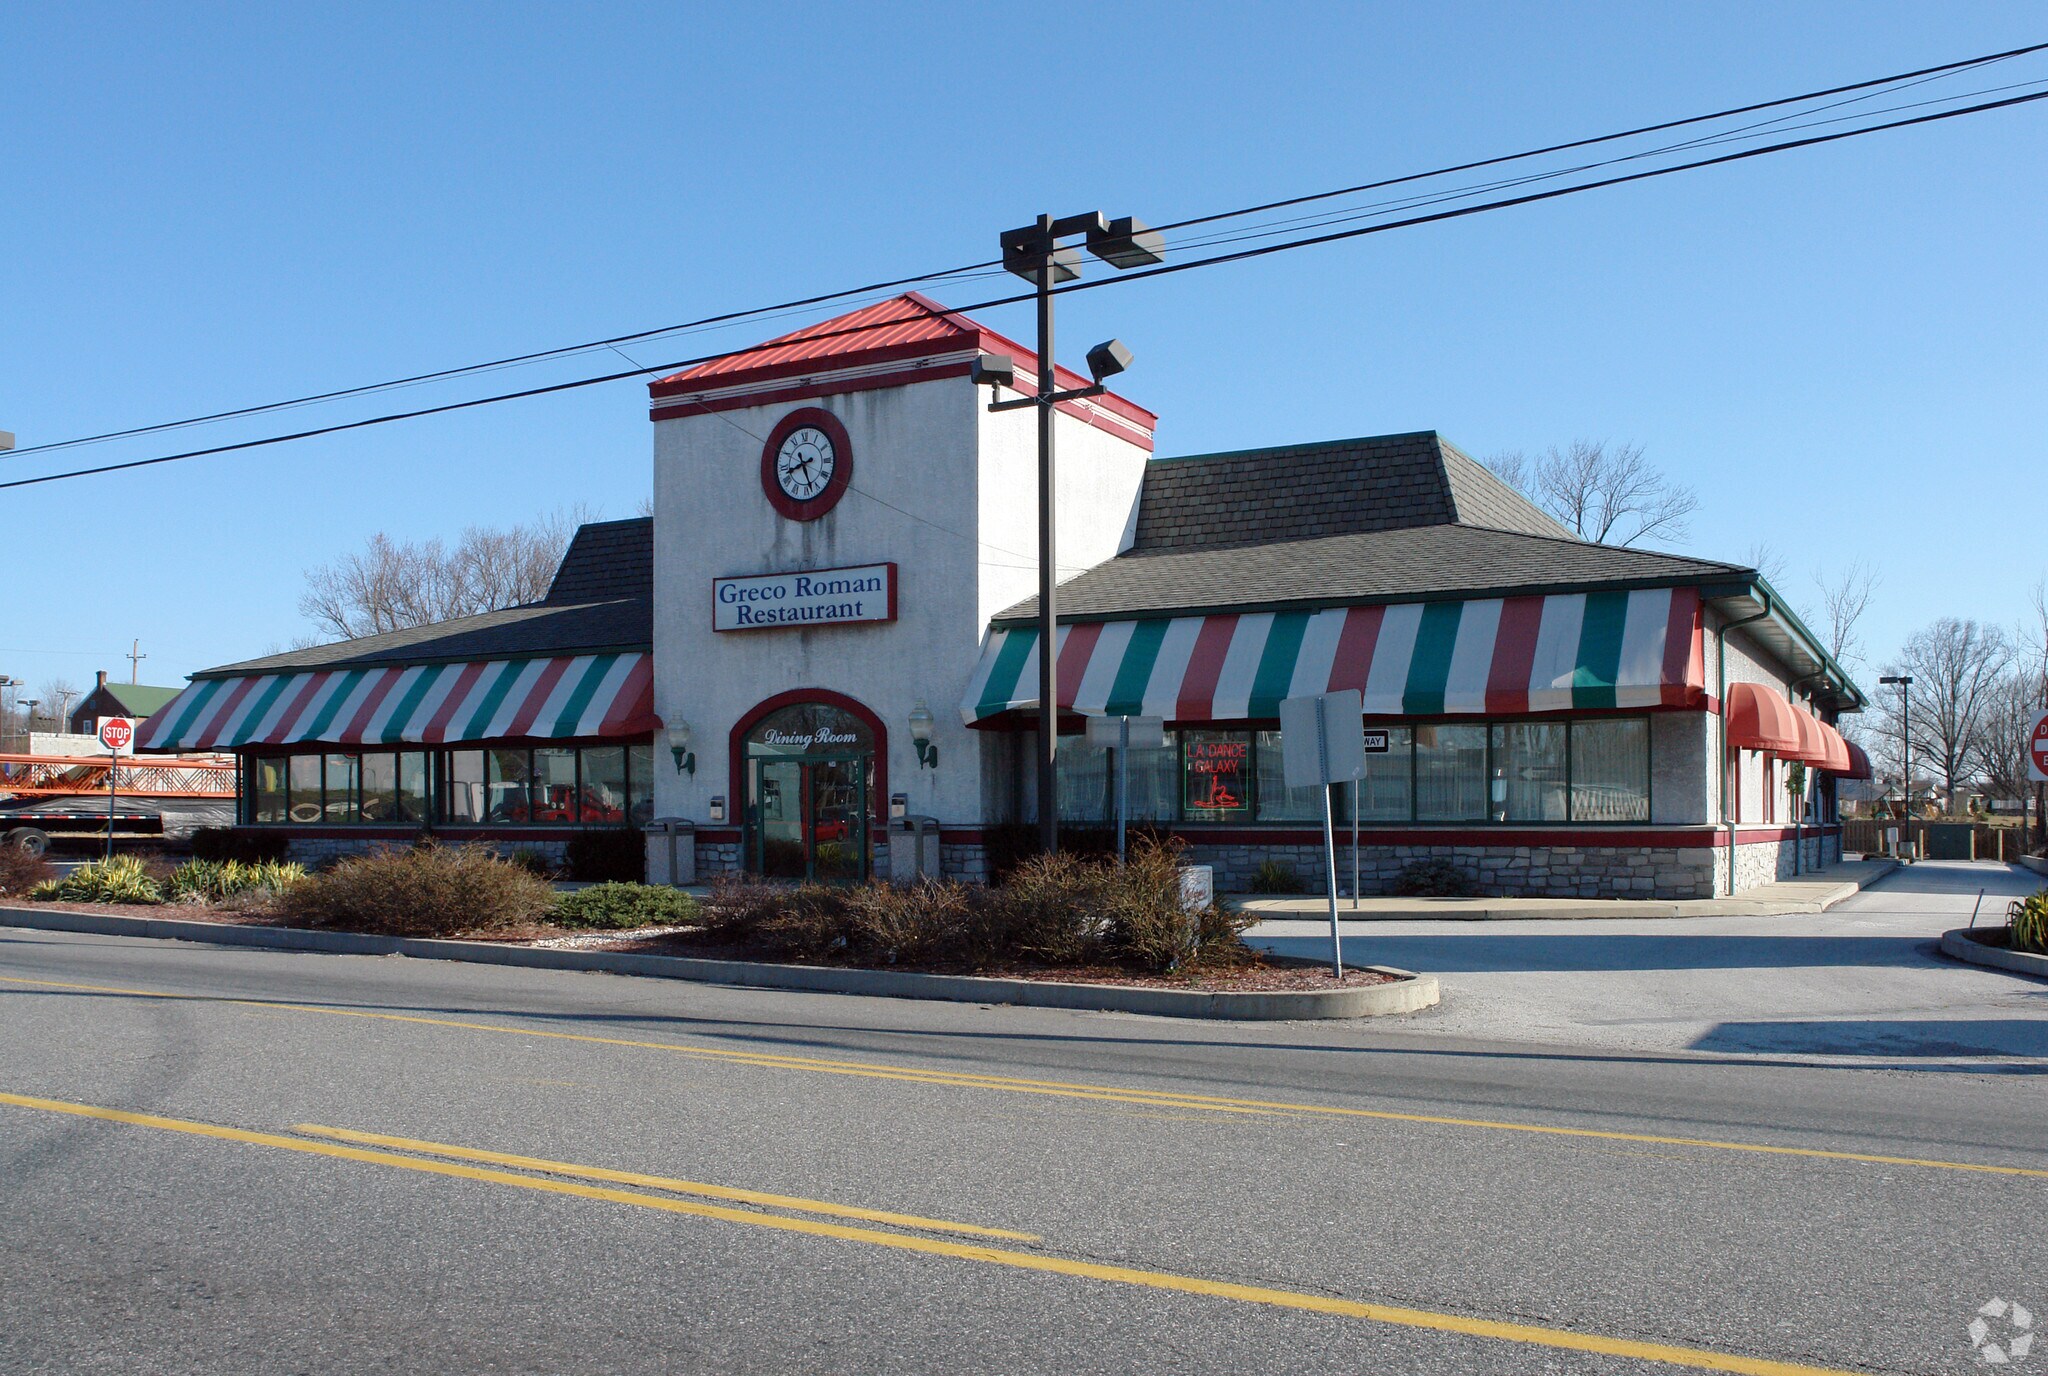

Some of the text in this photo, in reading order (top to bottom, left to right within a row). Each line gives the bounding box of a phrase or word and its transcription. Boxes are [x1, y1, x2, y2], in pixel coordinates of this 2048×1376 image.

[719, 576, 882, 604] Greco Roman
[735, 599, 864, 625] Restaurant
[105, 726, 131, 740] STOP
[764, 727, 858, 750] Dining Room
[1187, 743, 1247, 758] LA DANCE
[1195, 759, 1239, 773] GALAXY
